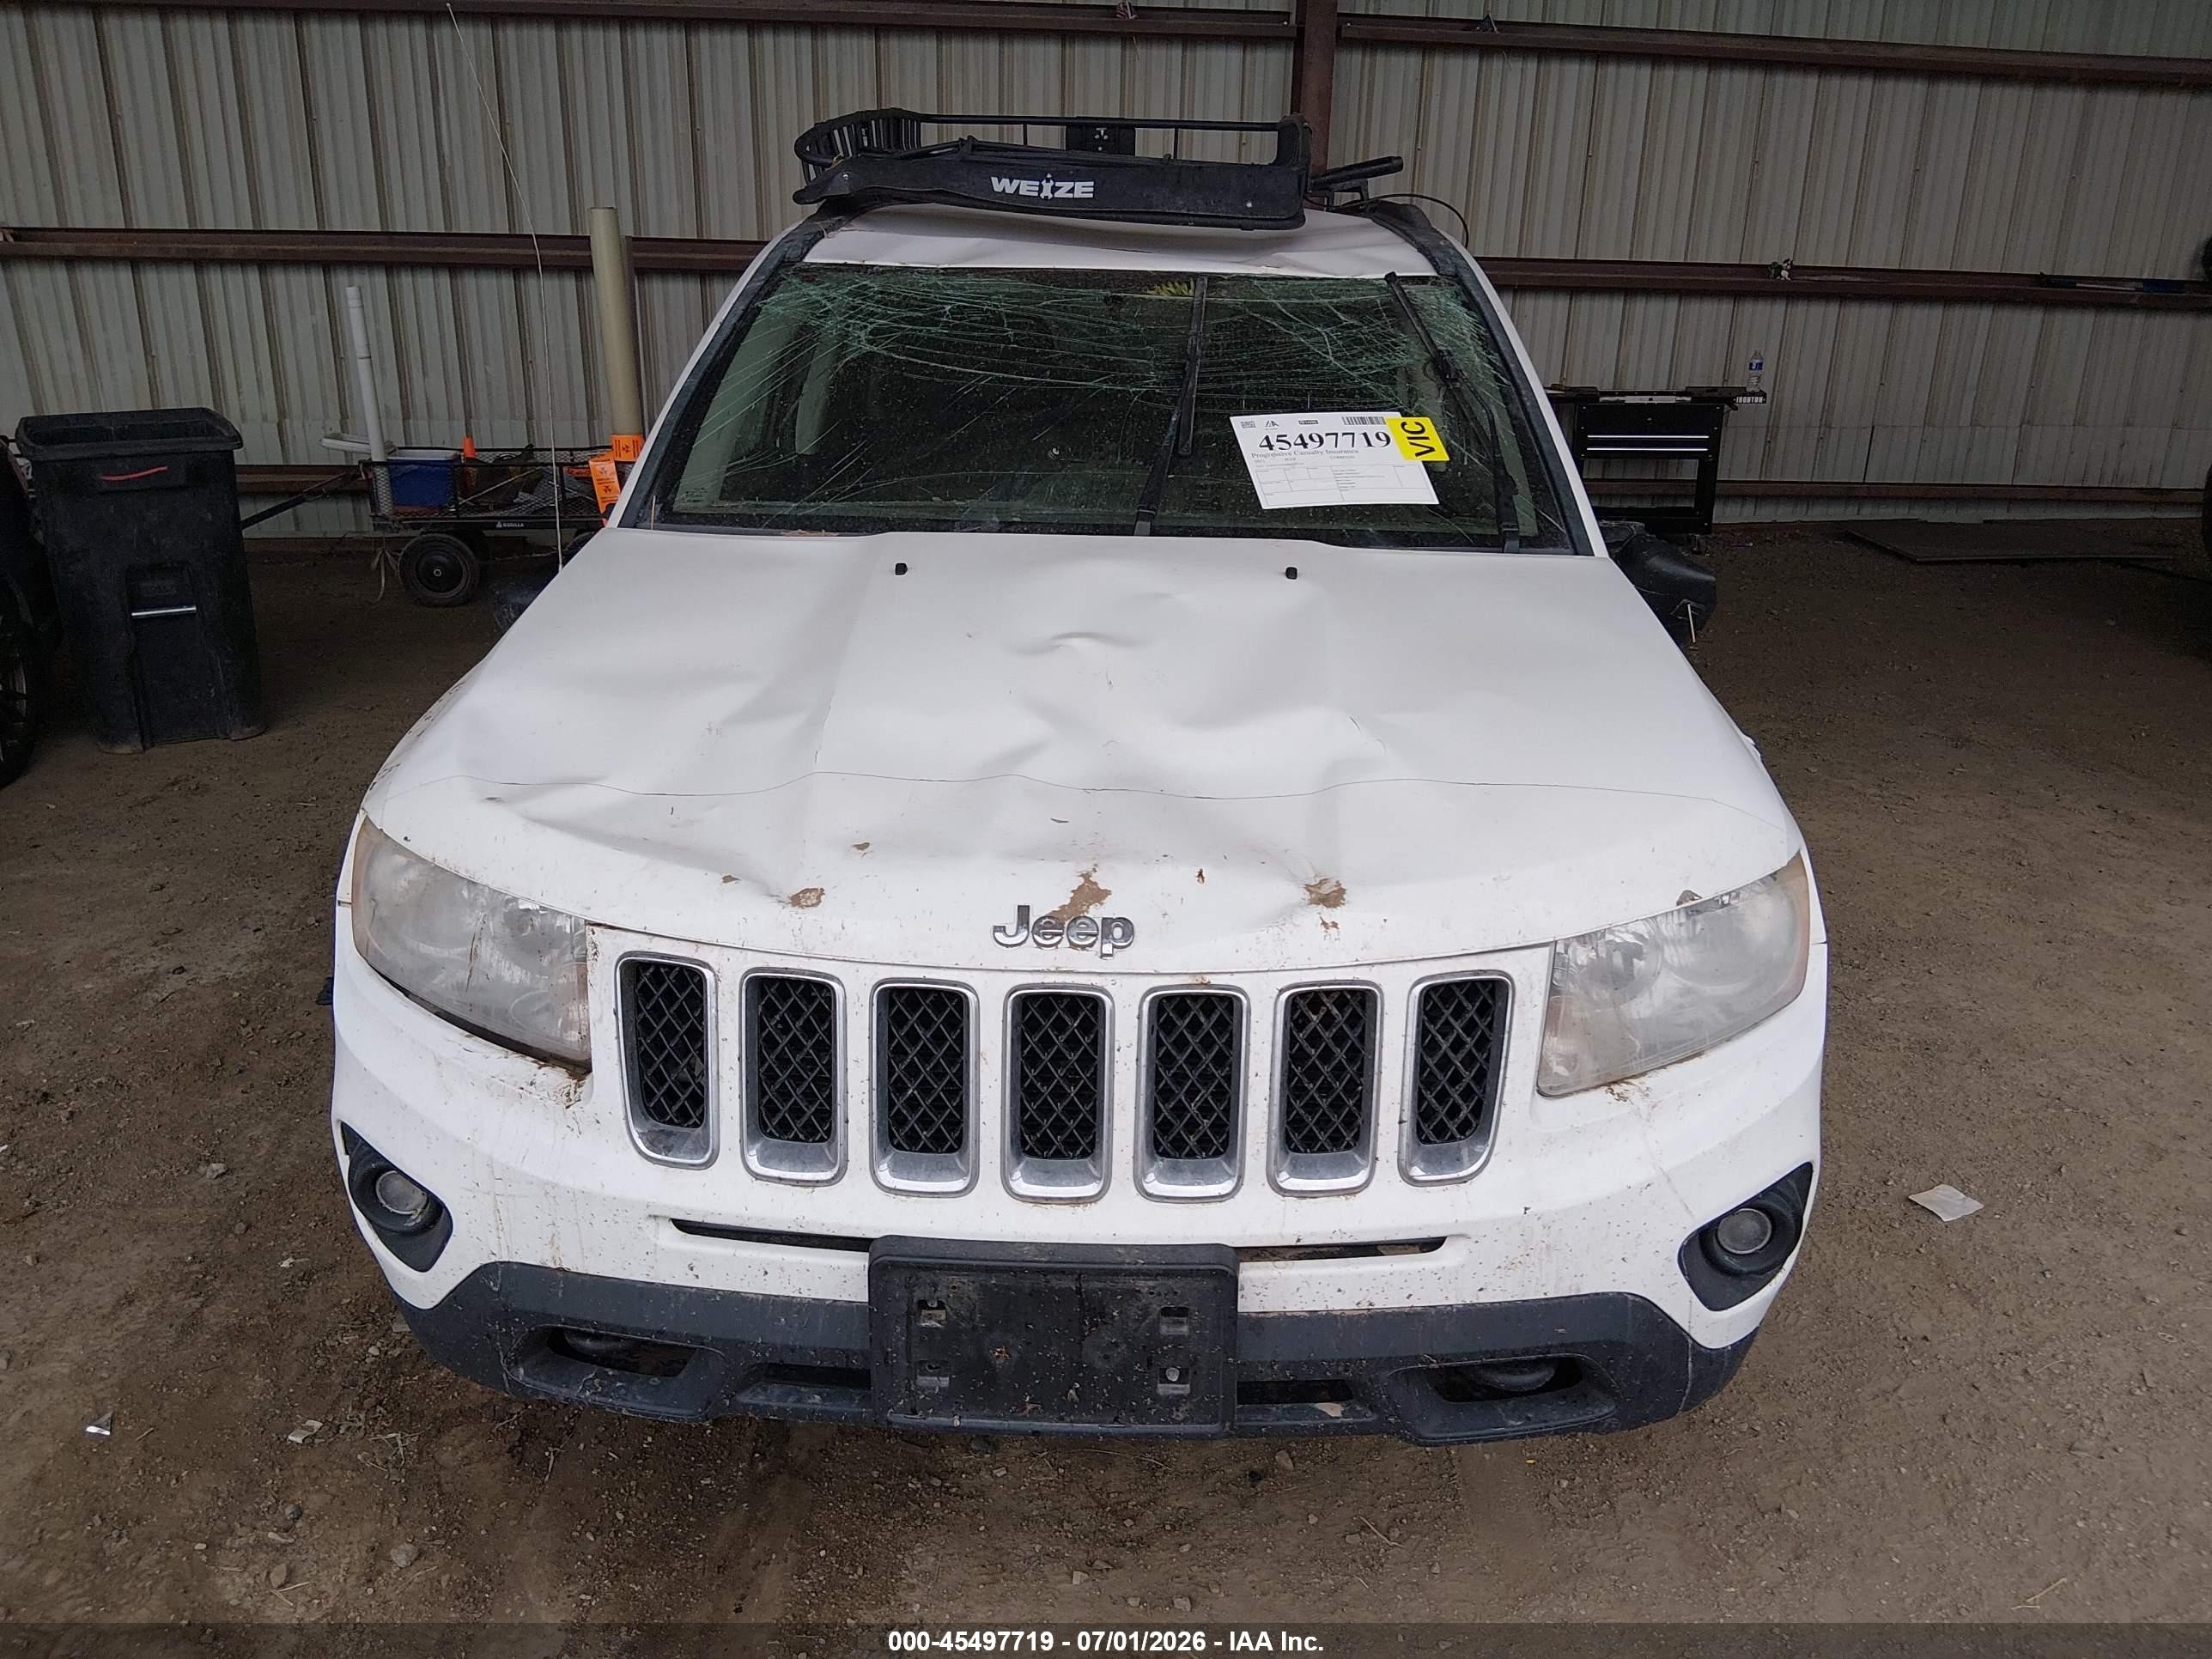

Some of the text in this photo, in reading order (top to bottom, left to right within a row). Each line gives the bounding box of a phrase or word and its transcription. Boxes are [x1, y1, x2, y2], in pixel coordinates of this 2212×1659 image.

[991, 173, 1095, 199] WEIZE
[1259, 431, 1391, 451] 45497719
[1400, 421, 1437, 457] VIC
[993, 905, 1134, 959] Jeep
